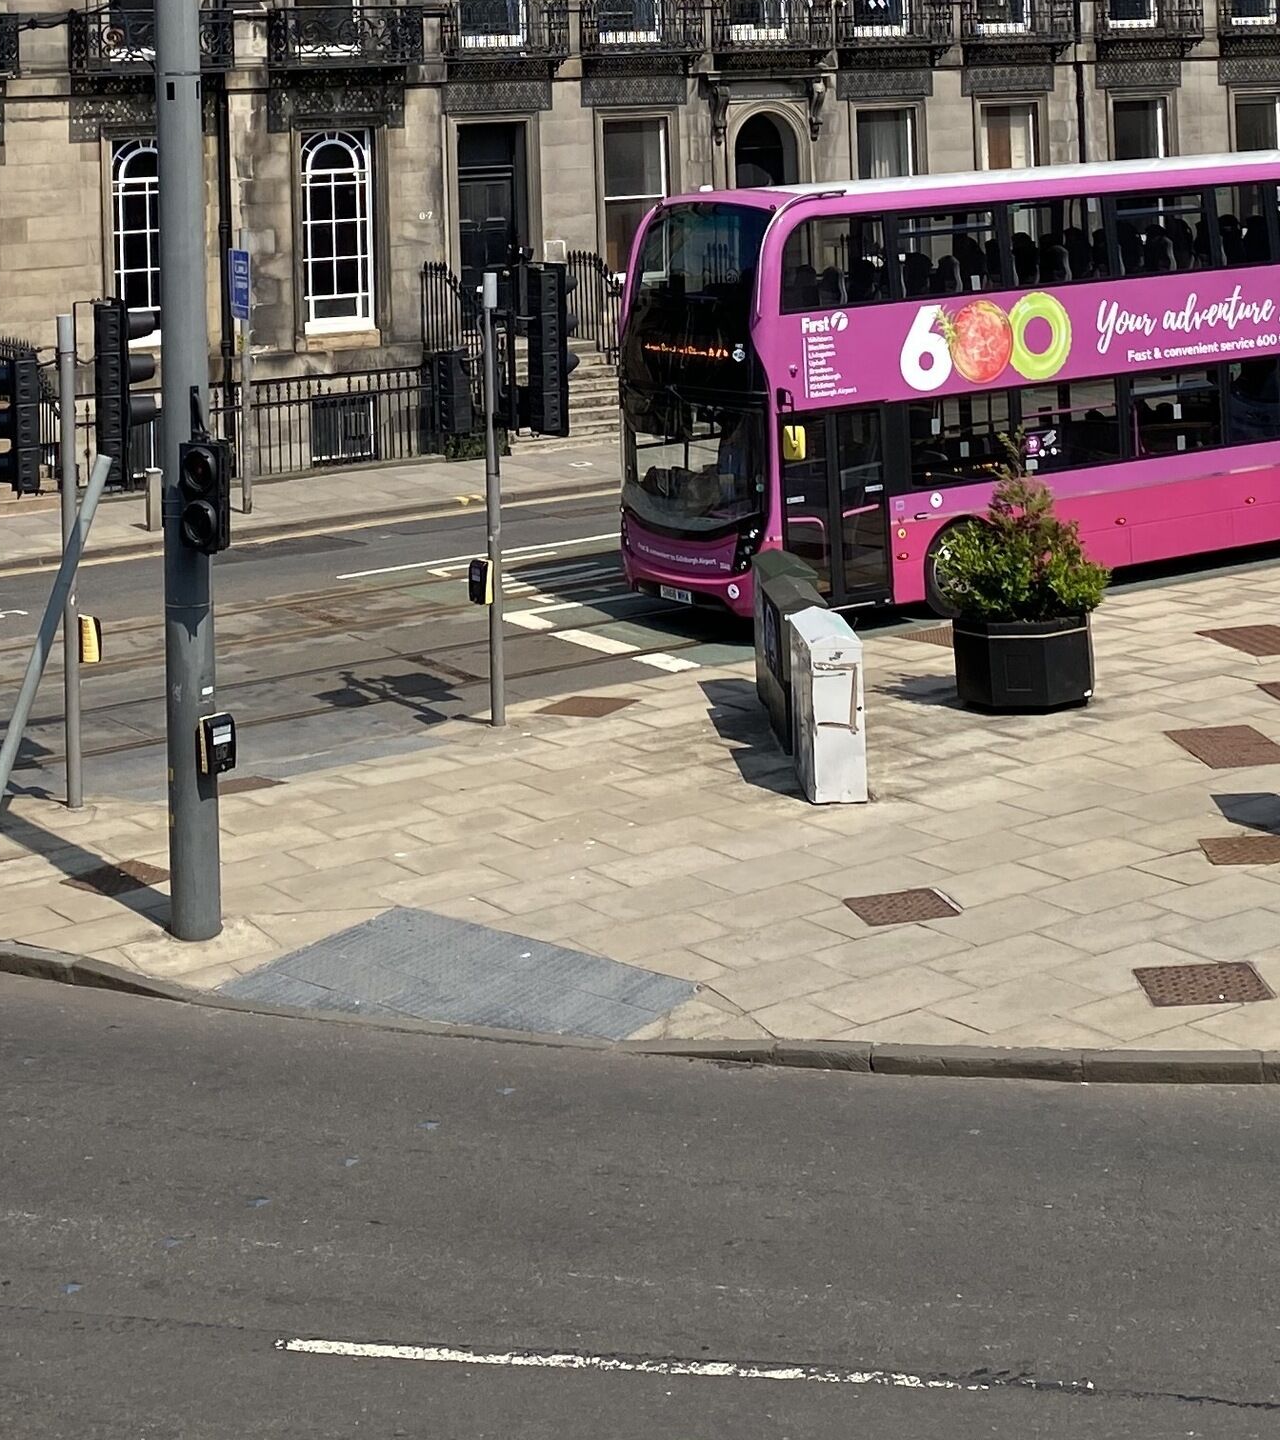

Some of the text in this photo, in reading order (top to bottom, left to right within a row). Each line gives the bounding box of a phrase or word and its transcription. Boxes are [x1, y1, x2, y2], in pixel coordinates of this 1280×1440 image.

[801, 316, 831, 335] First
[900, 291, 1072, 392] 600
[1096, 299, 1156, 354] Your
[1163, 285, 1275, 333] adventure
[1127, 349, 1152, 363] Fast
[1154, 348, 1162, 360] &
[1164, 341, 1219, 359] convenient
[1220, 337, 1255, 354] service
[1256, 334, 1278, 348] 600
